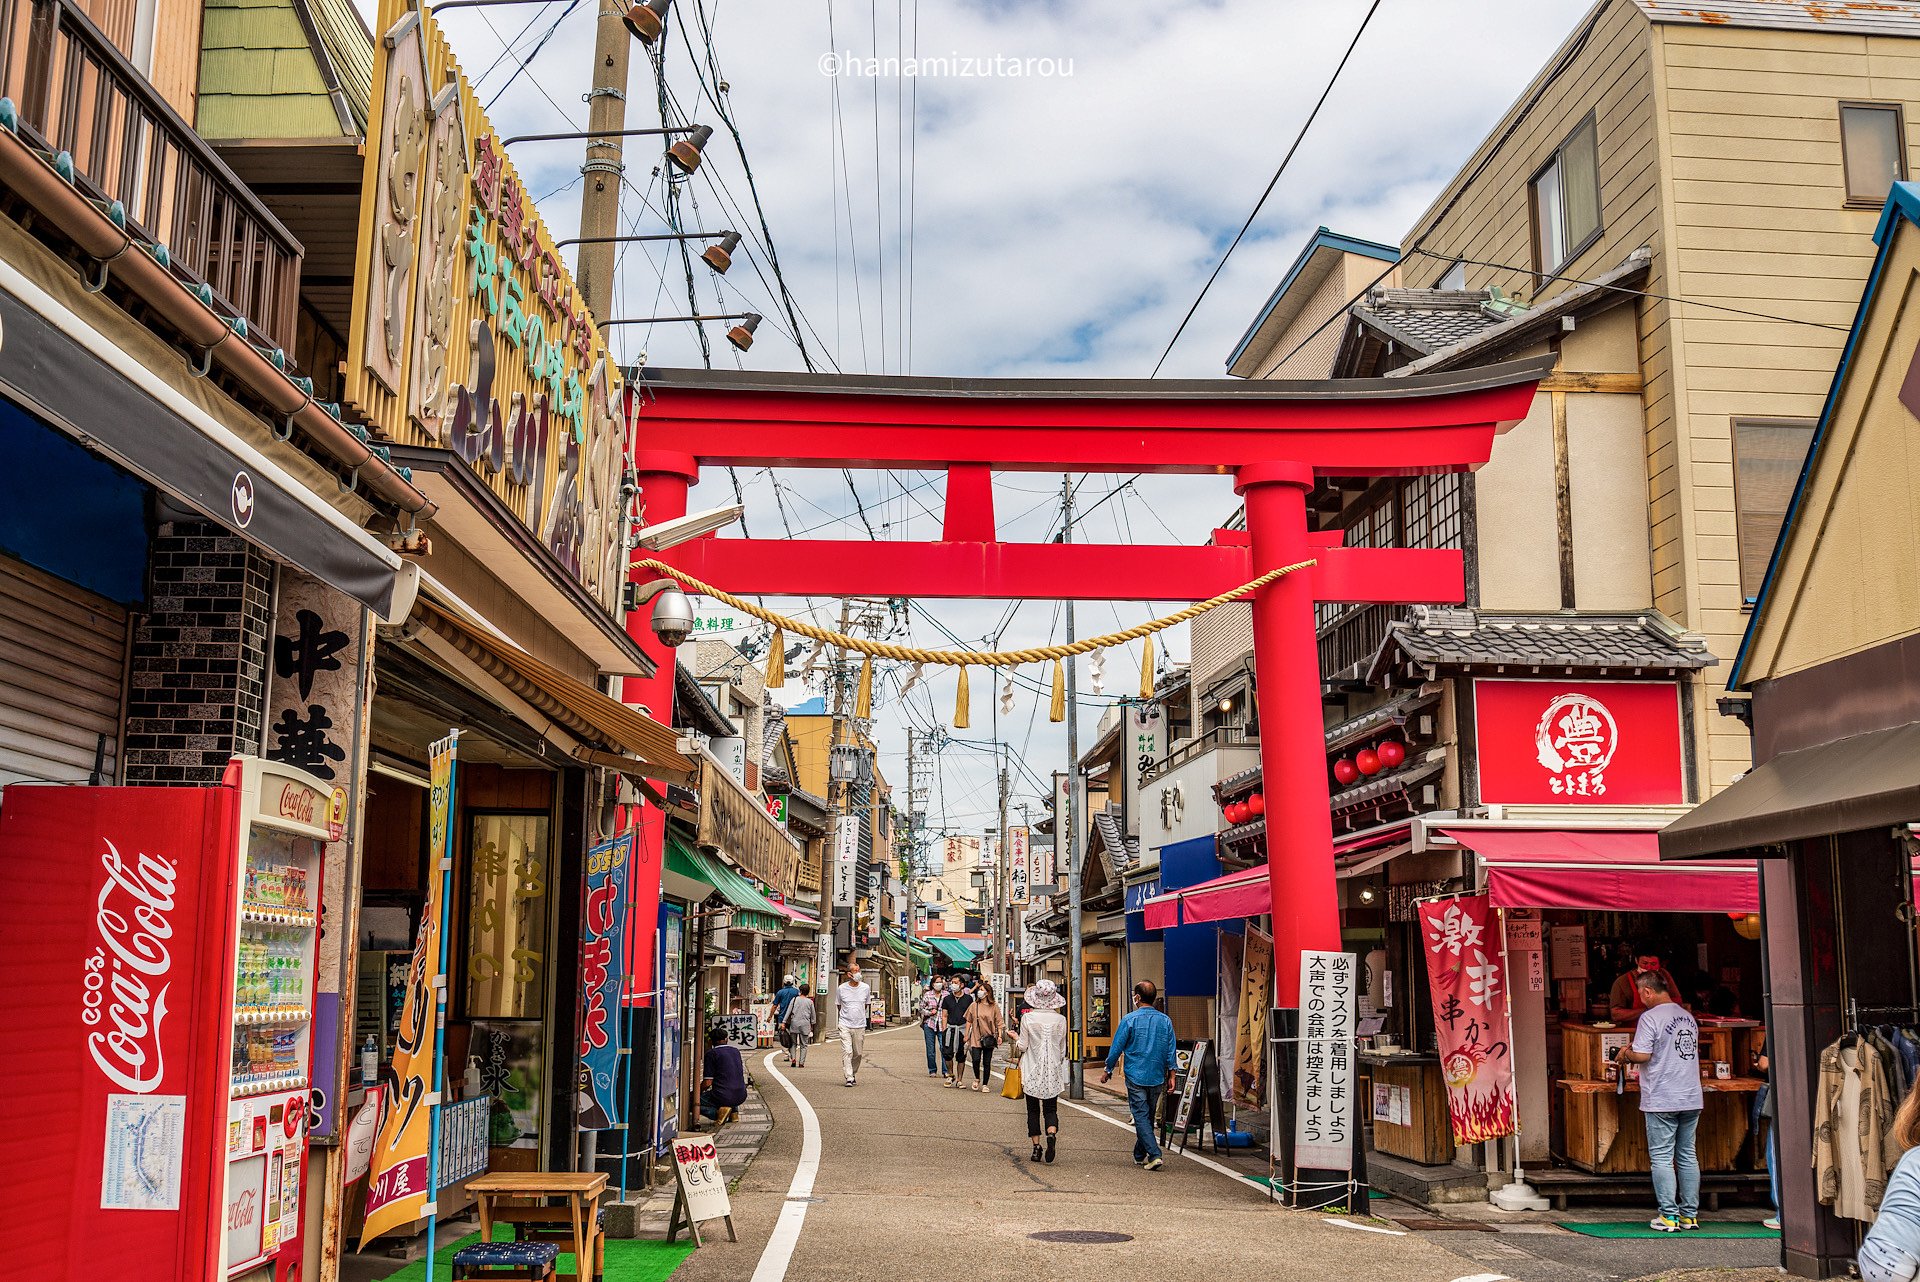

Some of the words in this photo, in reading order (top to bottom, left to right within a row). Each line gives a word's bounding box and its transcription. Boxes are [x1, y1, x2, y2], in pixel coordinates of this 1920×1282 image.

[466, 204, 584, 445] 秘伝の味処
[690, 616, 734, 631] 魚料理
[267, 609, 350, 780] 中華
[279, 782, 316, 823] Coca-Cola
[1549, 771, 1607, 796] とよまる
[1013, 831, 1025, 866] お食事処
[1011, 868, 1028, 900] 柏屋
[87, 836, 178, 1094] Coca-Cola
[1427, 902, 1502, 1011] 激辛
[726, 1016, 753, 1028] 川魚料理
[1304, 955, 1326, 1142] 大声での会話は控えましょう
[1328, 956, 1350, 1143] 必ずマスクを着用しましょう
[1440, 993, 1508, 1061] 串かつ
[480, 1029, 519, 1098] かき氷
[675, 1143, 717, 1165] 串かつ
